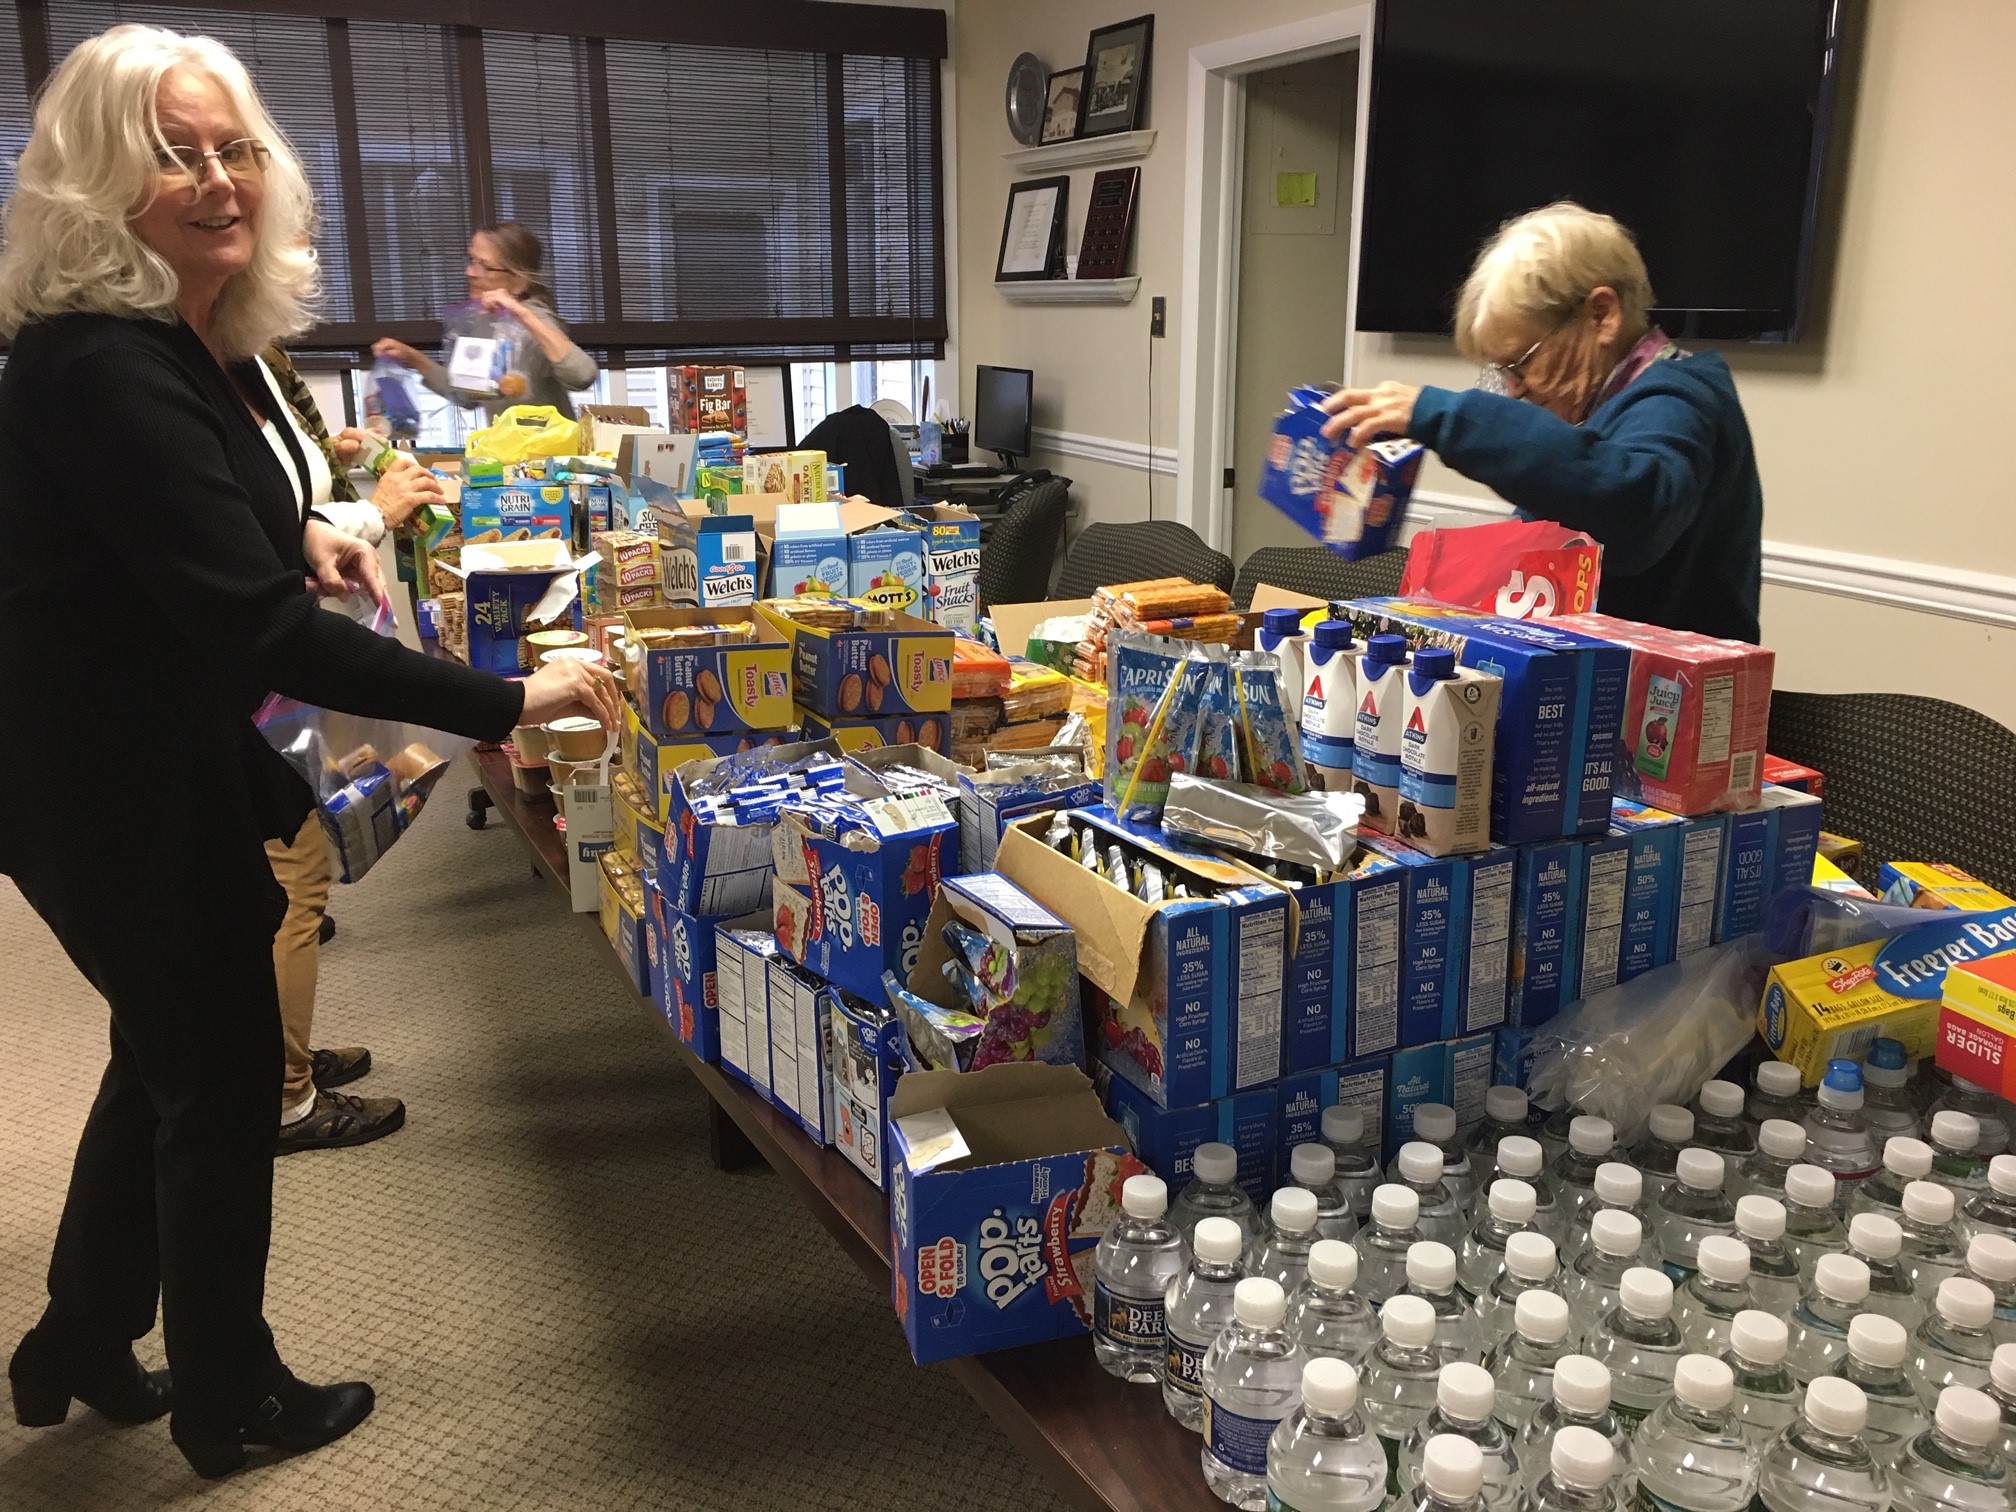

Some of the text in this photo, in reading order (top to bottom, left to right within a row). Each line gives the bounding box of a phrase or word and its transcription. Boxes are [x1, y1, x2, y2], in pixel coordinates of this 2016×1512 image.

[700, 399, 731, 413] Fig Bar
[801, 464, 810, 502] OATME
[500, 495, 530, 504] NUTRI
[501, 504, 531, 512] GRAIN
[642, 511, 658, 522] SO
[933, 526, 945, 536] 80
[619, 545, 650, 562] 10 PACKS
[933, 552, 979, 572] Welch's
[621, 568, 654, 584] 10 PACKS
[661, 554, 697, 591] Welch's
[706, 577, 753, 596] Welch's
[945, 581, 970, 597] Fruit
[1574, 554, 1592, 614] OPS
[621, 590, 653, 604] 10 PACKS
[936, 593, 975, 610] Snacks
[474, 601, 492, 625] 24
[492, 590, 503, 633] VARIETY
[500, 600, 509, 623] PACK
[517, 635, 529, 669] PLANTERS
[851, 639, 860, 669] Butter
[859, 639, 869, 671] Peanut
[674, 655, 683, 687] Butter
[685, 654, 694, 688] Peanut
[911, 651, 925, 693] Toasty
[933, 657, 946, 683] Lance
[745, 664, 760, 708] Toasty
[768, 671, 785, 697] Lance
[1650, 686, 1680, 704] Juicy
[1305, 698, 1324, 708] ATKINS
[1650, 697, 1676, 709] Juice
[1538, 704, 1565, 719] BEST
[1358, 714, 1377, 724] ATKINS
[1356, 729, 1379, 741] CHOCOLATE
[1361, 725, 1372, 733] DARK
[1405, 730, 1424, 742] ATKINS
[1358, 736, 1374, 746] ROYALE
[1408, 741, 1420, 751] DARK
[1402, 745, 1425, 759] CHOCOLATE
[1404, 753, 1421, 764] ROYALE
[1585, 761, 1612, 775] IT'S ALL
[1525, 780, 1561, 793] all-natural
[1582, 776, 1611, 792] GOOD.
[1521, 792, 1560, 806] ingredients.
[1643, 844, 1654, 854] ALL
[1547, 860, 1559, 871] ALL
[1592, 856, 1627, 867] Nutrition Facts
[1634, 852, 1661, 865] NATURAL
[1475, 869, 1512, 881] Nutrition Facts
[1538, 868, 1567, 882] NATURAL
[1637, 874, 1655, 885] 50%
[1736, 865, 1762, 880] IT'S ALL
[1427, 877, 1439, 888] ALL
[807, 854, 822, 933] Strawberry
[1359, 889, 1399, 903] Nutrition Facts
[1417, 886, 1449, 899] NATURAL
[1542, 891, 1561, 903] 35%
[1309, 898, 1322, 909] ALL
[861, 893, 871, 946] & FOLD
[1300, 906, 1332, 920] NATURAL
[1421, 909, 1442, 921] 35%
[1636, 910, 1650, 921] NO
[869, 902, 880, 946] OPEN
[1241, 916, 1284, 929] Nutrition Facts
[1416, 918, 1446, 928] LESS SUGAR
[1186, 927, 1200, 939] ALL
[1304, 930, 1326, 943] 35%
[1542, 928, 1555, 939] NO
[1176, 935, 1210, 951] NATURAL
[1634, 943, 1647, 953] NO
[1878, 912, 2016, 988] Freezer Bag
[1176, 946, 1210, 957] INGREDIENTS
[1422, 947, 1437, 959] NO
[1181, 960, 1204, 974] 35%
[1539, 962, 1553, 972] NO
[1177, 970, 1209, 982] LESS SUGAR
[1307, 969, 1322, 980] NO
[1832, 967, 1872, 993] ShopRite
[704, 973, 717, 1007] OPEN
[1420, 981, 1434, 993] NO
[1185, 1001, 1200, 1013] NO
[1306, 1003, 1321, 1016] NO
[1812, 994, 1884, 1016] 14 GALLON SIZE
[1997, 1004, 2016, 1020] Bags
[1175, 1011, 1209, 1024] High Fructose
[1191, 1018, 1207, 1028] Syrup
[1768, 988, 1782, 1045] Freezer Bags
[1946, 1022, 2003, 1052] STORAGE BAGS
[1976, 1028, 2004, 1044] GALLON
[1185, 1038, 1200, 1050] NO
[1946, 1030, 2002, 1065] SLIDER
[1341, 1076, 1382, 1089] Nutrition Facts
[1396, 1081, 1430, 1093] Natural
[1408, 1075, 1421, 1086] All
[1295, 1089, 1308, 1101] ALL
[1285, 1099, 1318, 1113] NATURAL
[1285, 1108, 1319, 1118] INGREDIENTS
[1528, 1112, 1542, 1122] NO
[1238, 1121, 1266, 1132] Everything
[1291, 1121, 1312, 1134] 35%
[1286, 1131, 1316, 1141] LESS SUGAR
[1174, 1157, 1195, 1174] BES
[1032, 1164, 1041, 1203] Microwave
[1041, 1167, 1050, 1199] Friendly
[1047, 1207, 1074, 1288] Strawberry
[921, 1248, 937, 1292] OPEN
[938, 1239, 954, 1296] & FOLD
[956, 1246, 964, 1286] TO DISPLAY
[1128, 1307, 1164, 1321] DEE
[1128, 1321, 1164, 1334] PAR
[1123, 1335, 1142, 1344] NATURAL
[1182, 1366, 1204, 1381] PA
